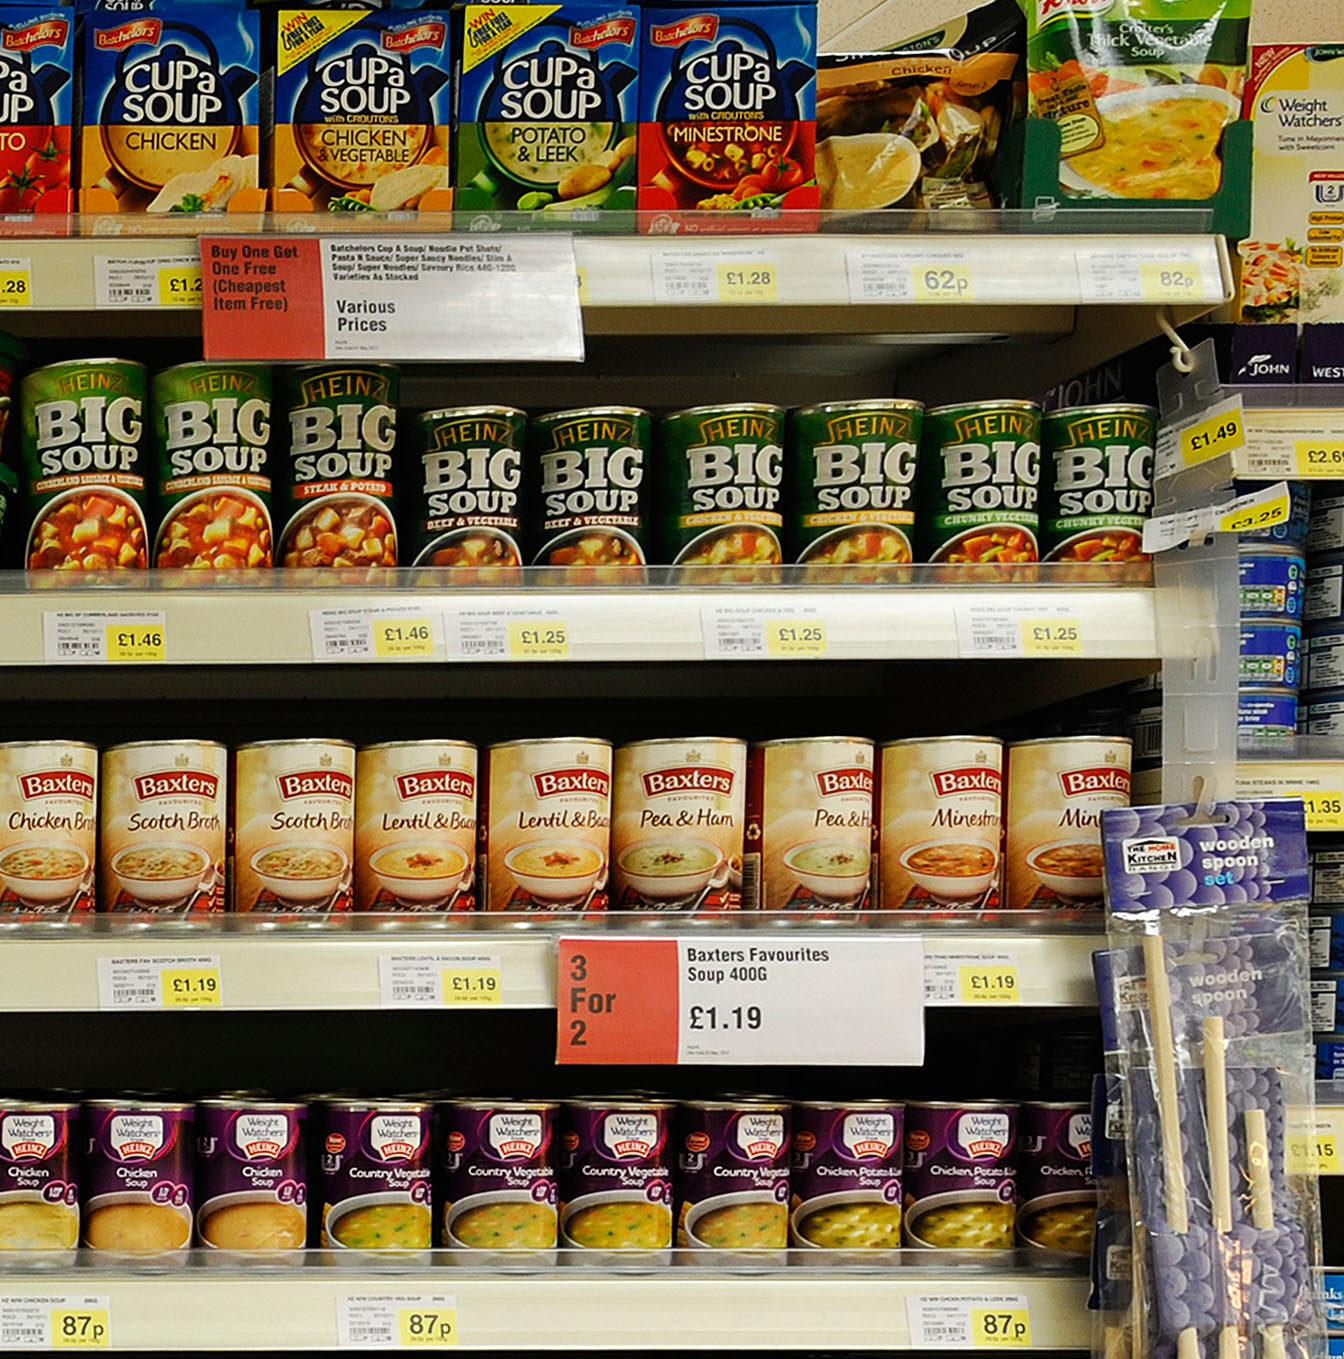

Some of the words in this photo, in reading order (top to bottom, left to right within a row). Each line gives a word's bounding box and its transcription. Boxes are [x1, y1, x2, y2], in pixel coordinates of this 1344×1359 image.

[1279, 98, 1328, 118] Weight
[512, 127, 586, 146] POTATO
[518, 147, 532, 163] &
[536, 145, 578, 163] LEEK
[212, 246, 238, 260] Buy
[242, 246, 268, 258] One
[274, 246, 298, 259] Get
[212, 263, 238, 276] One
[244, 263, 276, 276] Free
[213, 280, 285, 295] (Cheapest
[924, 270, 968, 298] 62p
[1160, 271, 1193, 289] 82p
[214, 298, 246, 311] Item
[251, 298, 288, 312] Free)
[337, 300, 395, 314] Various
[338, 318, 387, 332] Prices
[289, 405, 396, 455] BIG
[1190, 422, 1237, 450] £1.49
[294, 452, 392, 481] SOUP
[384, 626, 429, 643] £1.46
[647, 772, 731, 796] Baxters
[640, 810, 671, 829] Pea
[676, 810, 692, 828] &
[695, 810, 734, 829] Ham
[1199, 836, 1274, 852] wooden
[1202, 855, 1259, 871] spoon
[1204, 872, 1234, 886] set
